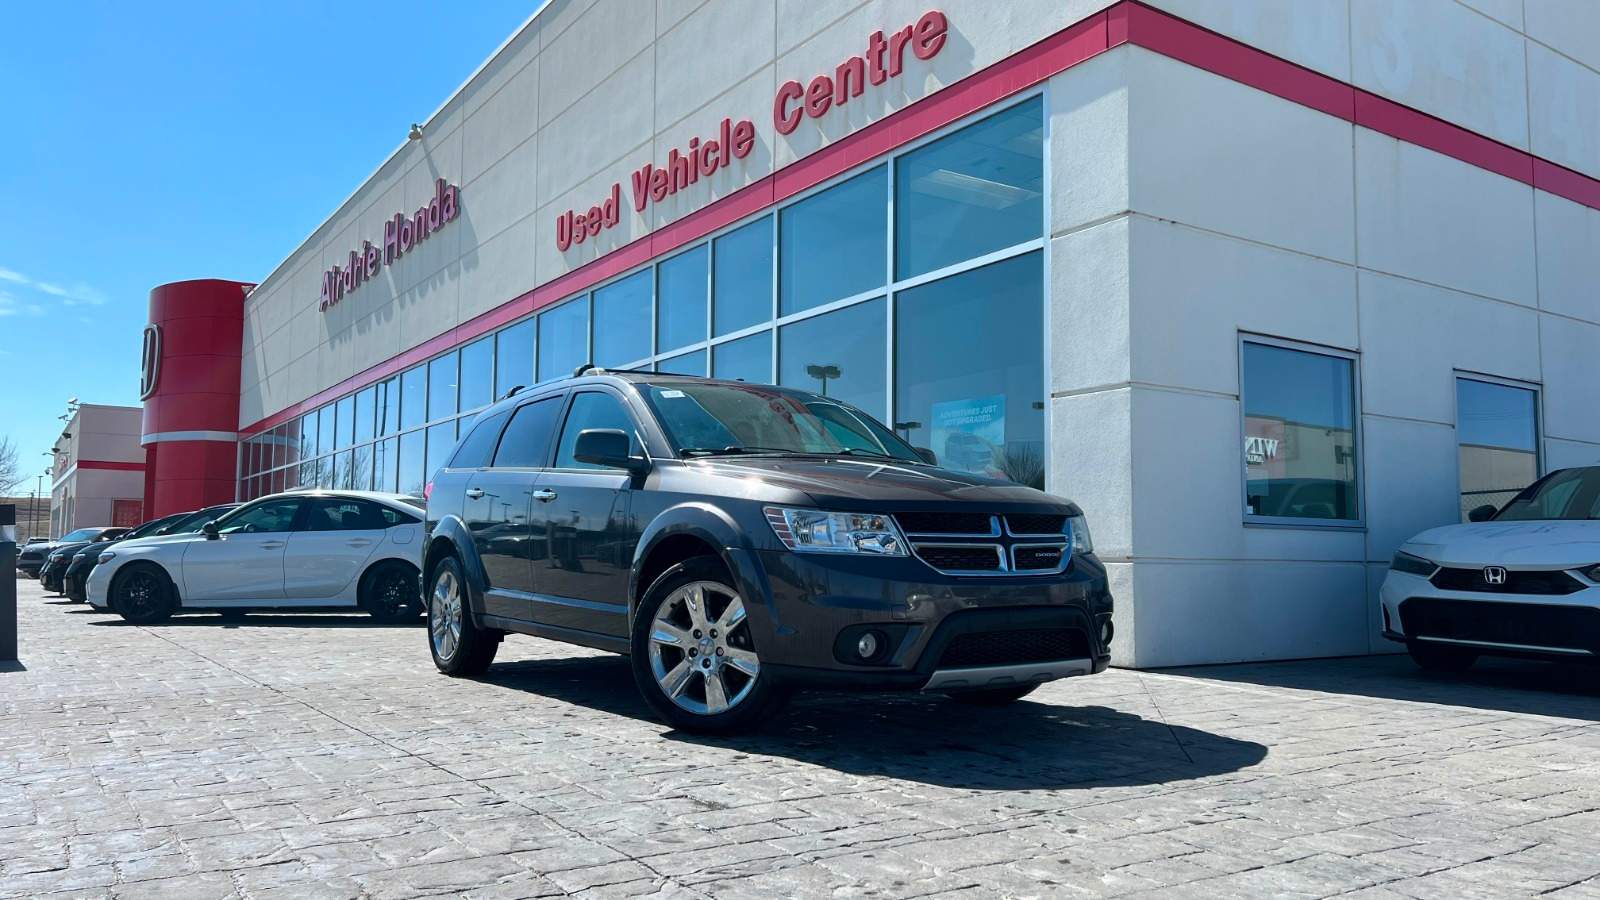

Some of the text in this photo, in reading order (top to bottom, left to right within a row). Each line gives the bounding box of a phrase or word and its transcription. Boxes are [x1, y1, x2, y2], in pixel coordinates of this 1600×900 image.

[556, 11, 948, 252] Used Vehicle Centre
[319, 178, 461, 312] Airdrie Honda
[980, 404, 998, 414] JUST
